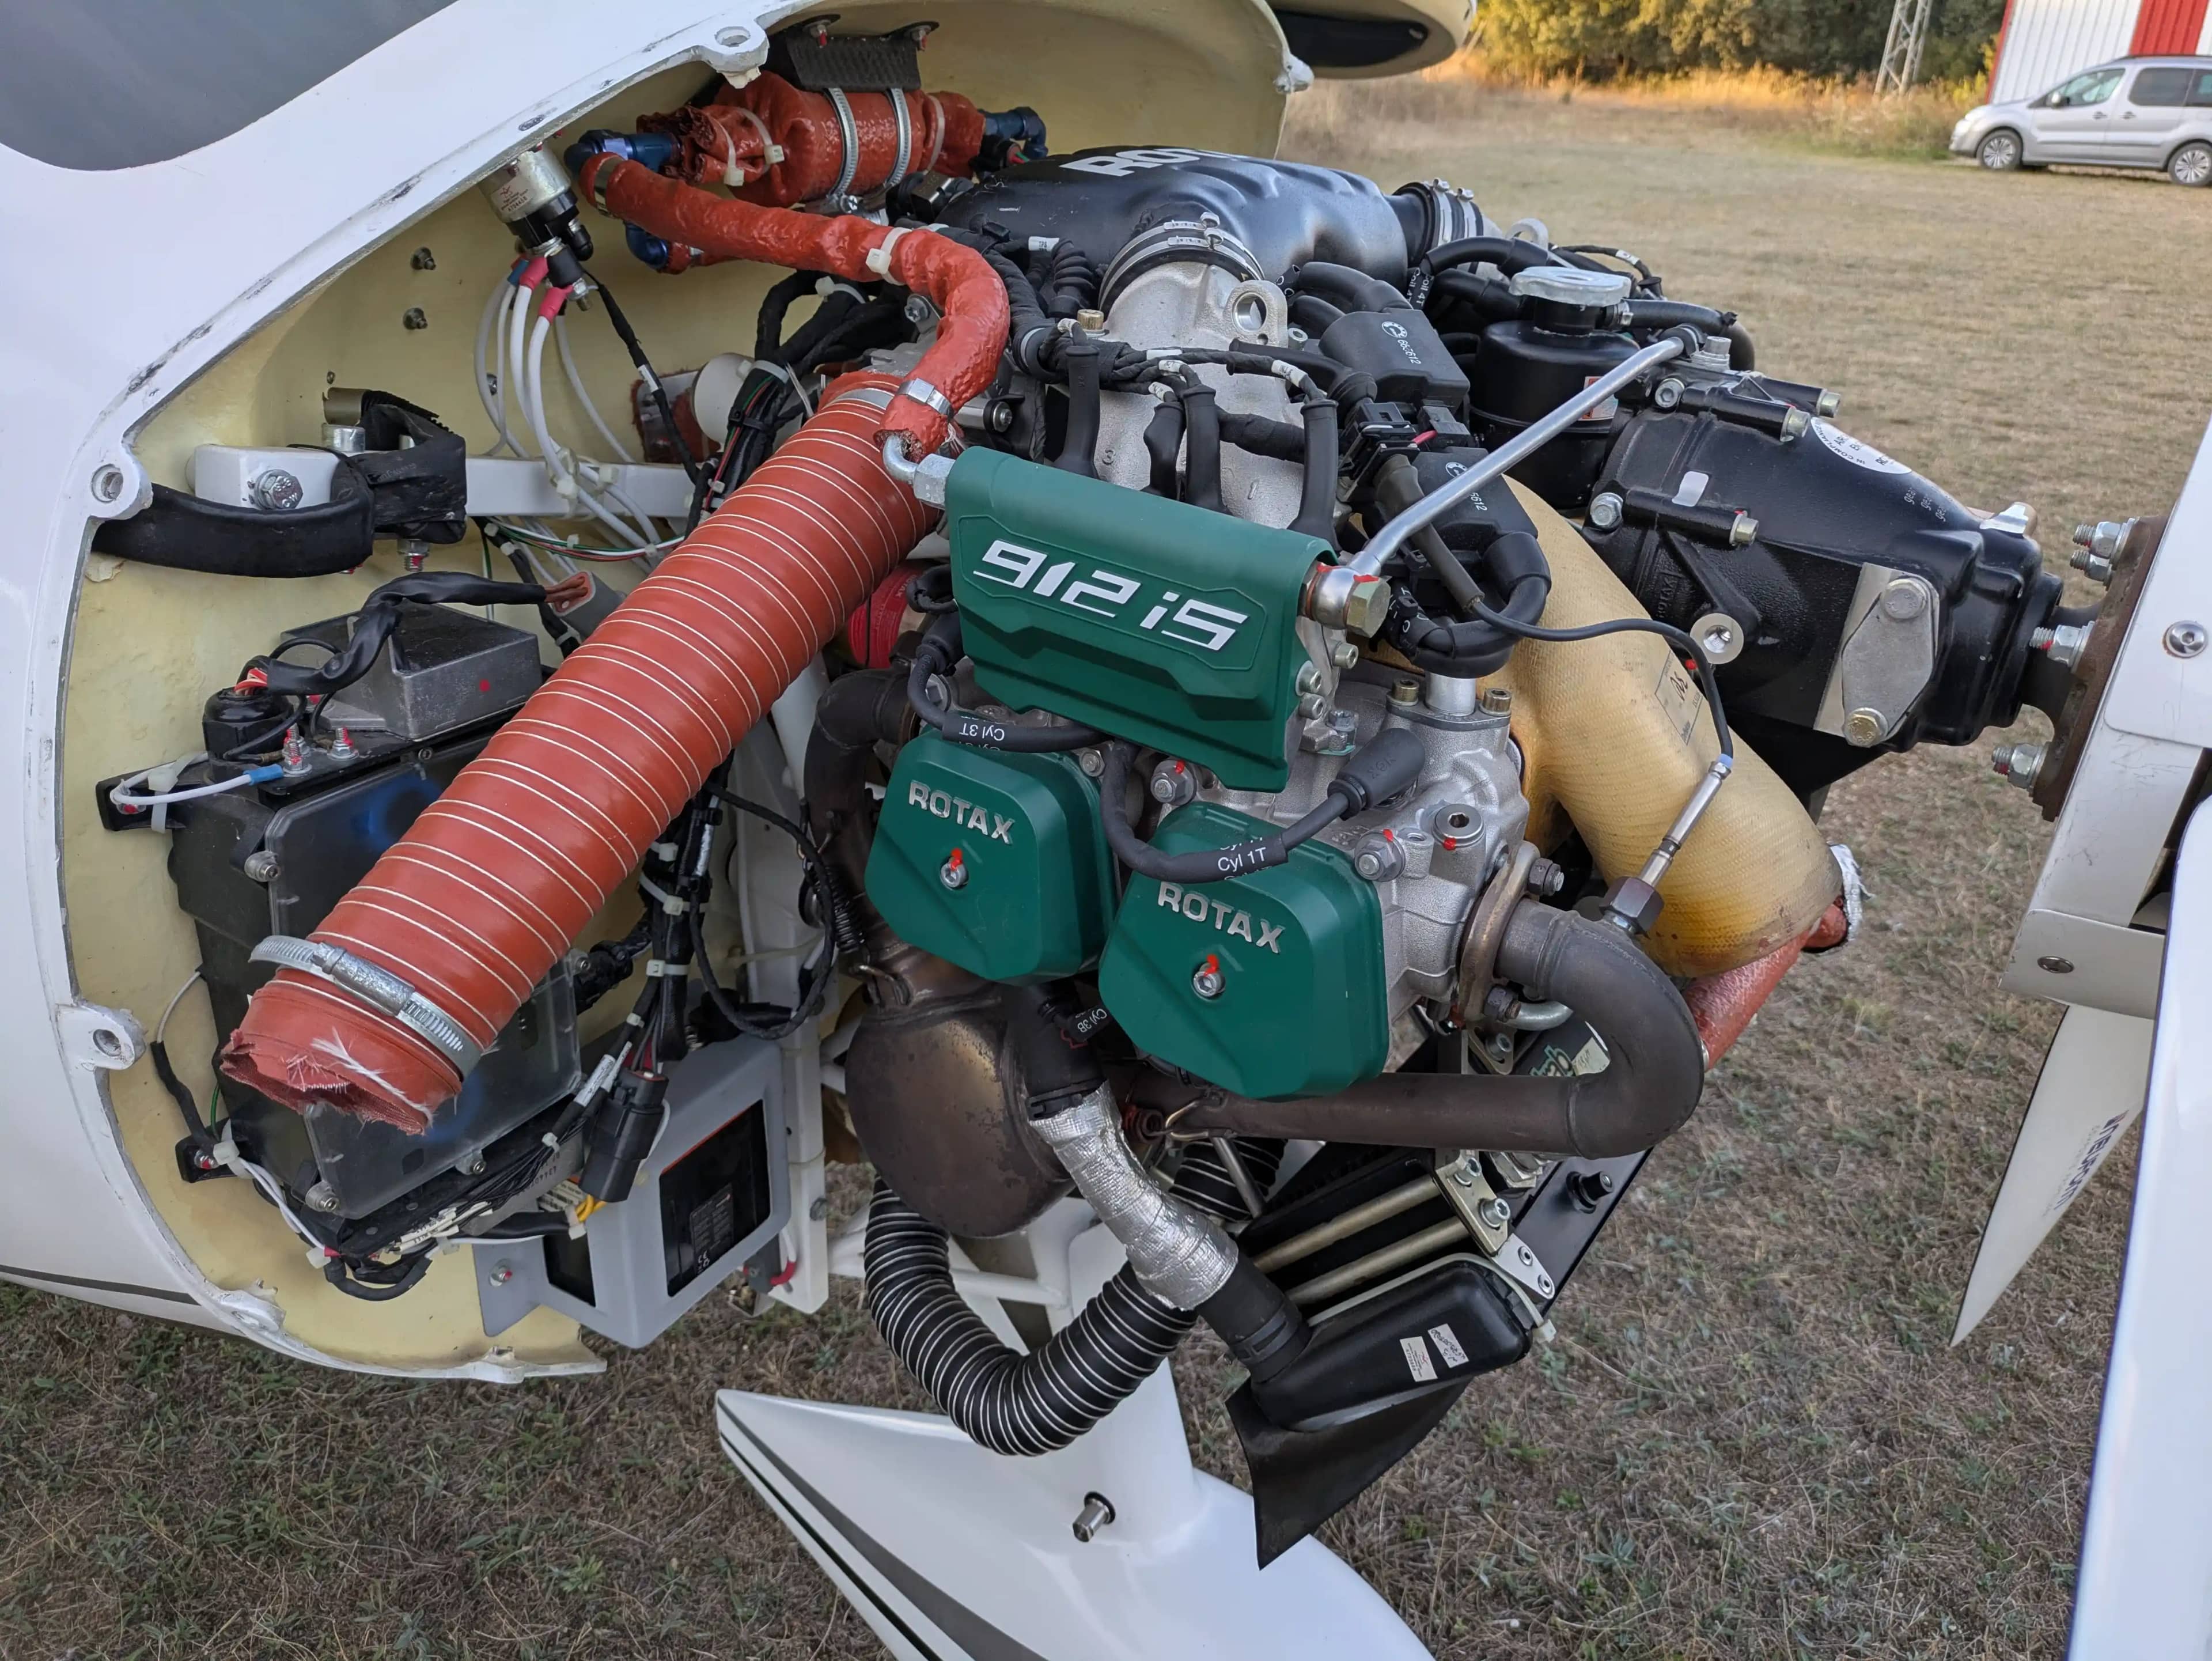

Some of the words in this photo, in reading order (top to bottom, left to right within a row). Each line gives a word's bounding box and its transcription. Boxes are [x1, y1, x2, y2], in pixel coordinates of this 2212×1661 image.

[1416, 292, 1426, 307] 4T
[1470, 492, 1487, 511] 5612
[973, 540, 1141, 618] 912
[959, 723, 978, 737] 3T
[982, 725, 1005, 741] Cyl
[909, 780, 1016, 845] ROTAX
[1218, 854, 1243, 872] Cyl
[1247, 847, 1266, 864] 1T
[1158, 881, 1286, 954] ROTAX
[1089, 1008, 1107, 1024] Cyl
[1077, 1019, 1092, 1032] 3B
